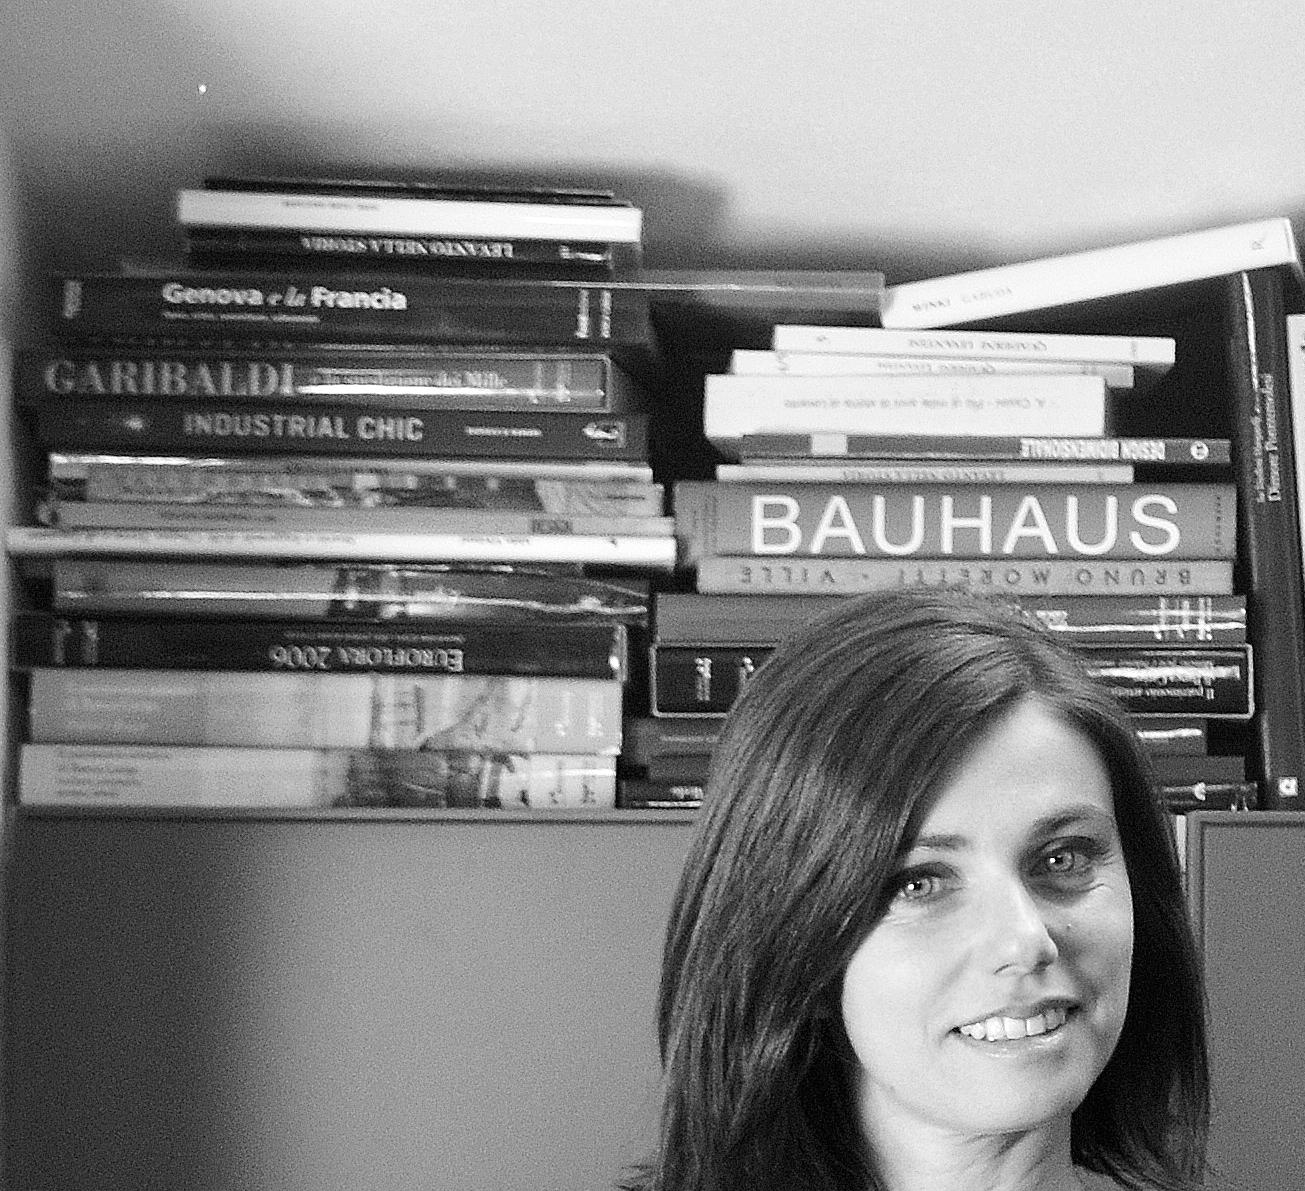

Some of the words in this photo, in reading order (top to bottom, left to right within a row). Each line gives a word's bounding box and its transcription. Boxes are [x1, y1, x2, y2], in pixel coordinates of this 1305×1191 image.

[366, 238, 429, 255] NELLA
[162, 283, 264, 306] Genova
[310, 286, 408, 310] Francia
[45, 361, 296, 397] GARIBALDI
[185, 413, 349, 438] INDUSTRIAL
[356, 415, 425, 441] CHIC
[750, 494, 1182, 556] BAUHAUS
[738, 566, 837, 587] VILLE
[1076, 566, 1191, 587] BRUNO
[269, 645, 332, 670] 2006
[337, 646, 465, 672] EUROFLORA
